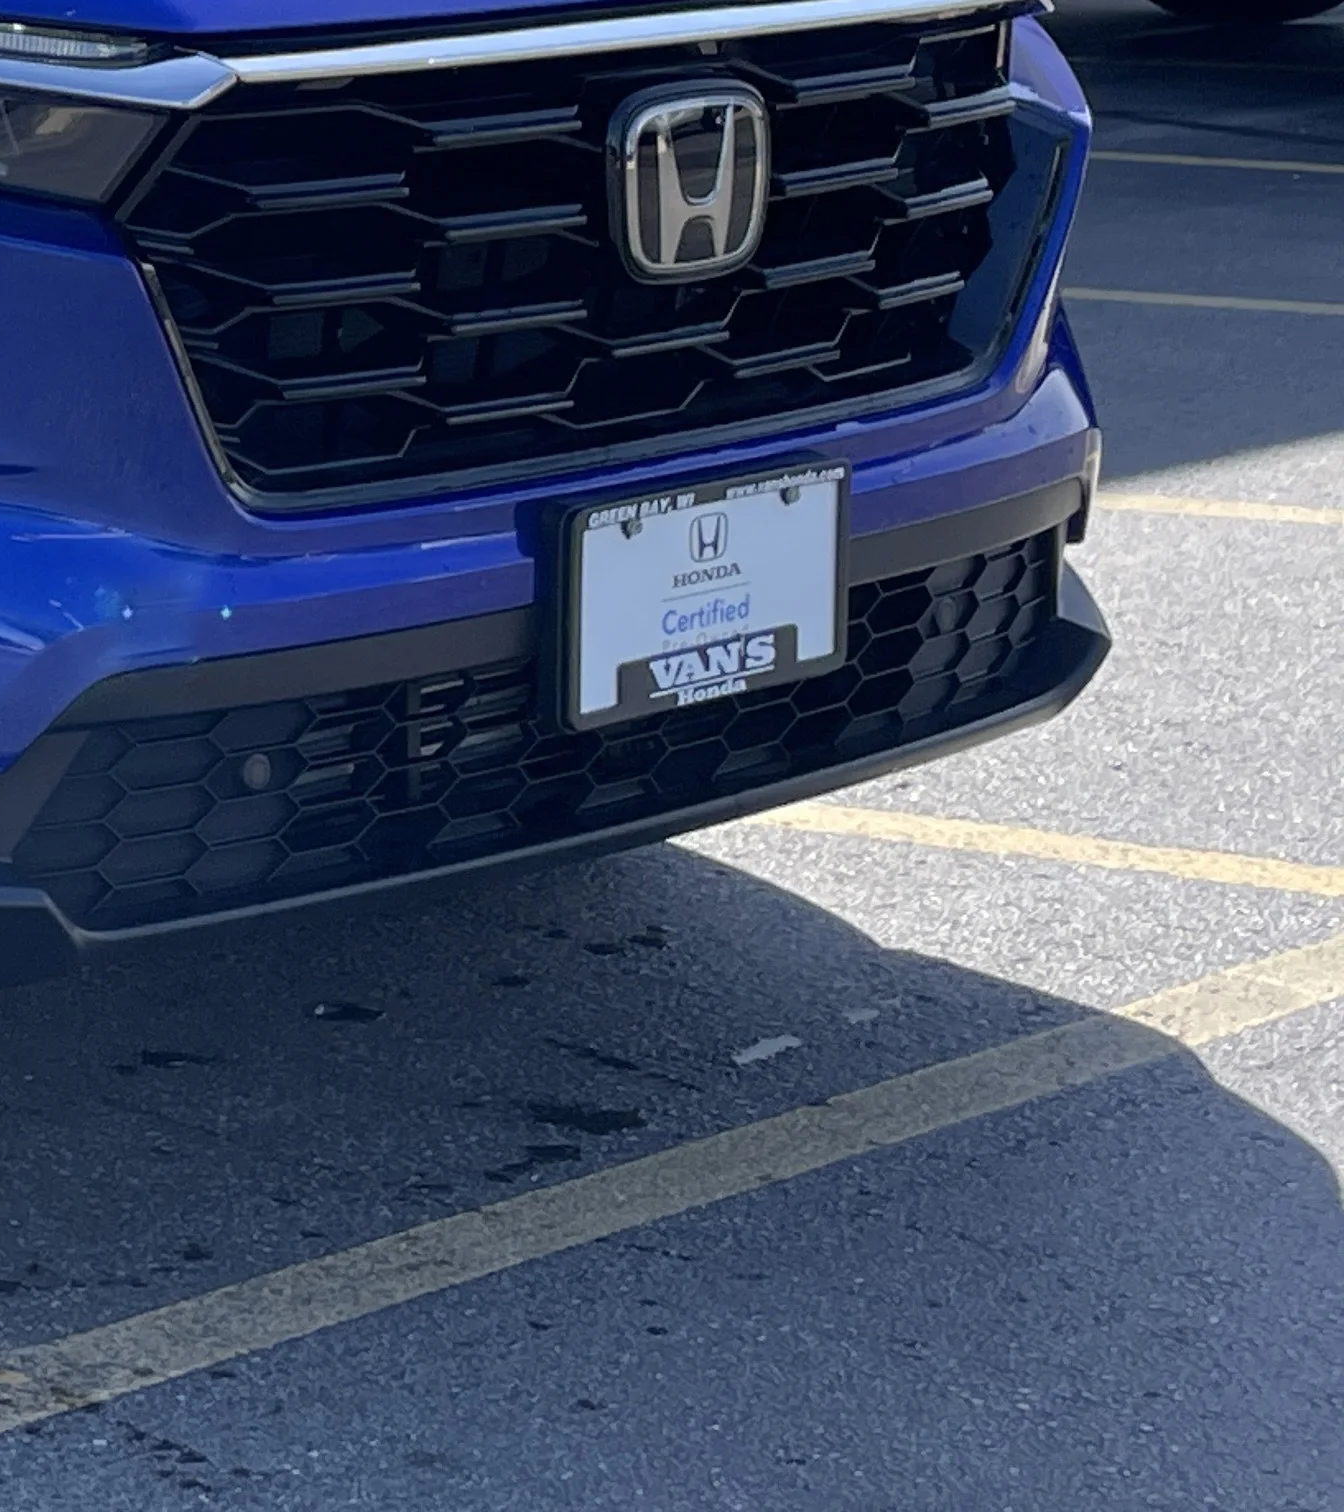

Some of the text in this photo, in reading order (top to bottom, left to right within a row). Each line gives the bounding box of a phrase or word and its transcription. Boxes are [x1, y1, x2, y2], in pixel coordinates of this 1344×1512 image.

[672, 563, 742, 588] HONDA
[662, 592, 750, 635] Certified
[676, 677, 749, 707] Honda
